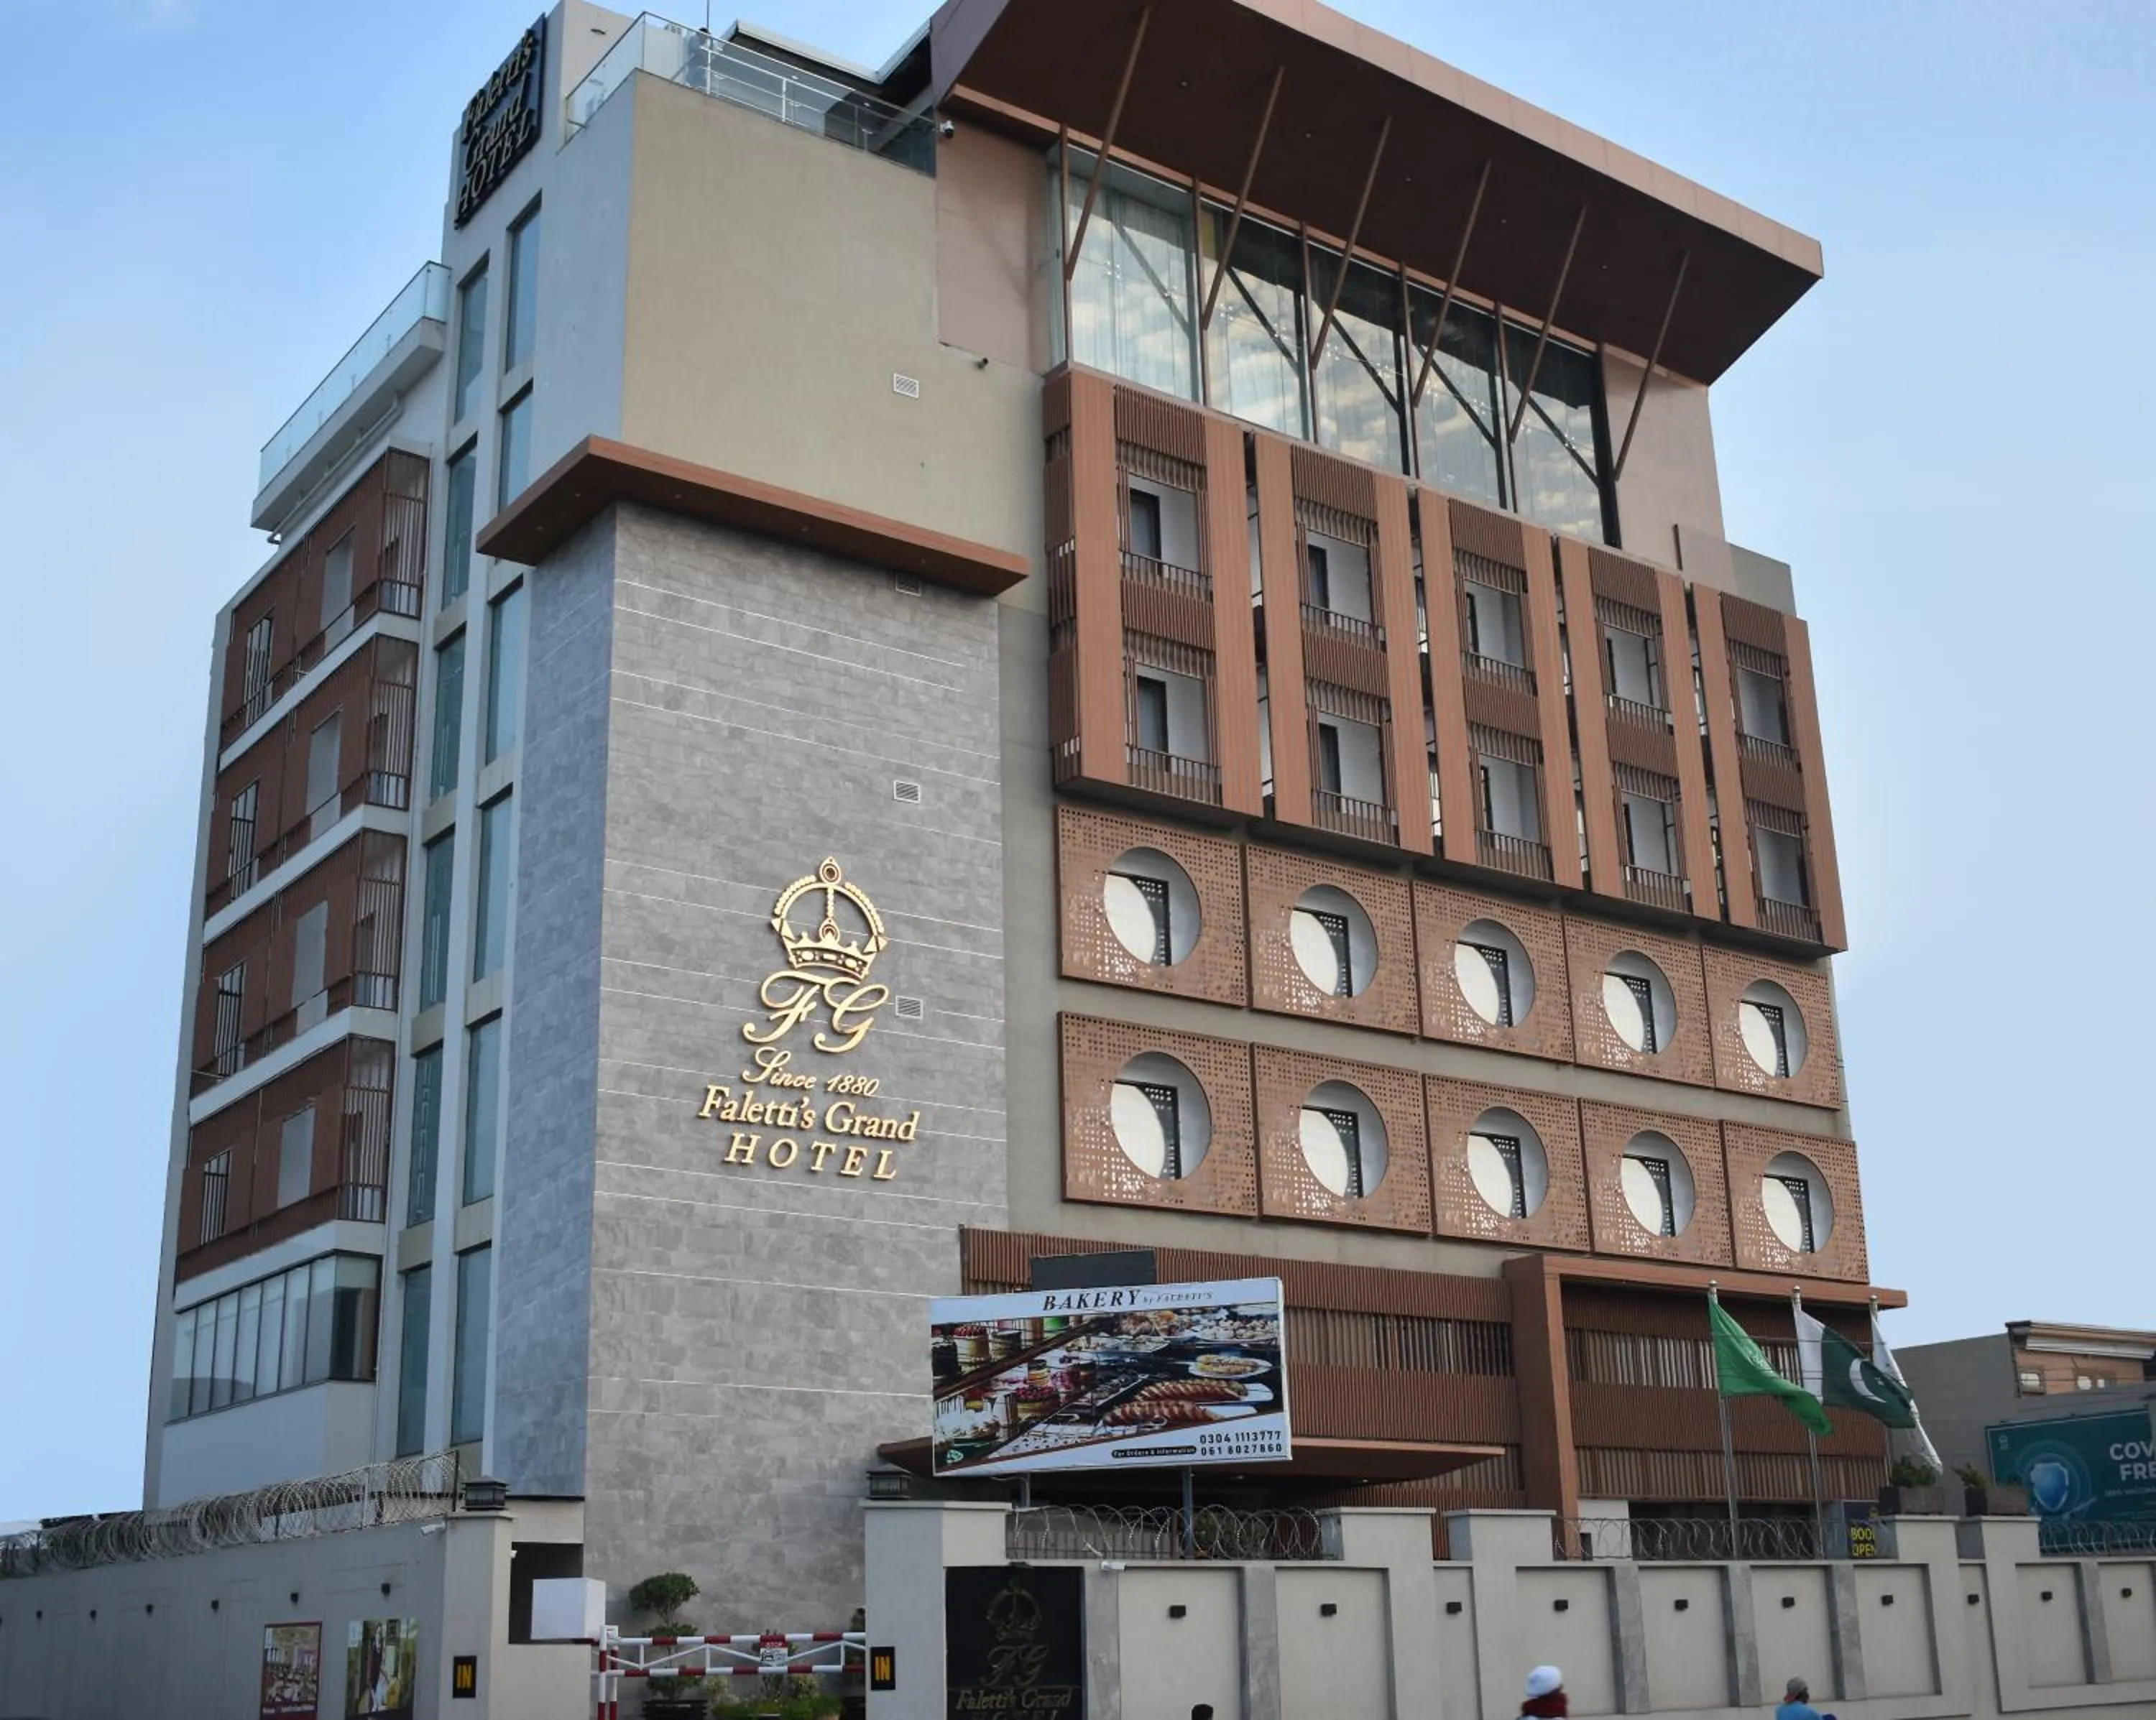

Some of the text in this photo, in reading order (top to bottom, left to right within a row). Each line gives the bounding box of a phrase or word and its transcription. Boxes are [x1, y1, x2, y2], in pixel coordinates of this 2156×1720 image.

[456, 108, 535, 218] HOTEL
[742, 1047, 880, 1096] Since 1880
[698, 1084, 921, 1141] Faletti's Grand
[724, 1132, 897, 1179] HOTEL
[1043, 1289, 1141, 1310] BAKERY
[1199, 1430, 1282, 1444] 0304 1113777
[1201, 1446, 1222, 1456] 061
[1851, 1527, 1875, 1540] BOO
[457, 1664, 472, 1688] IN
[875, 1655, 890, 1681] IN
